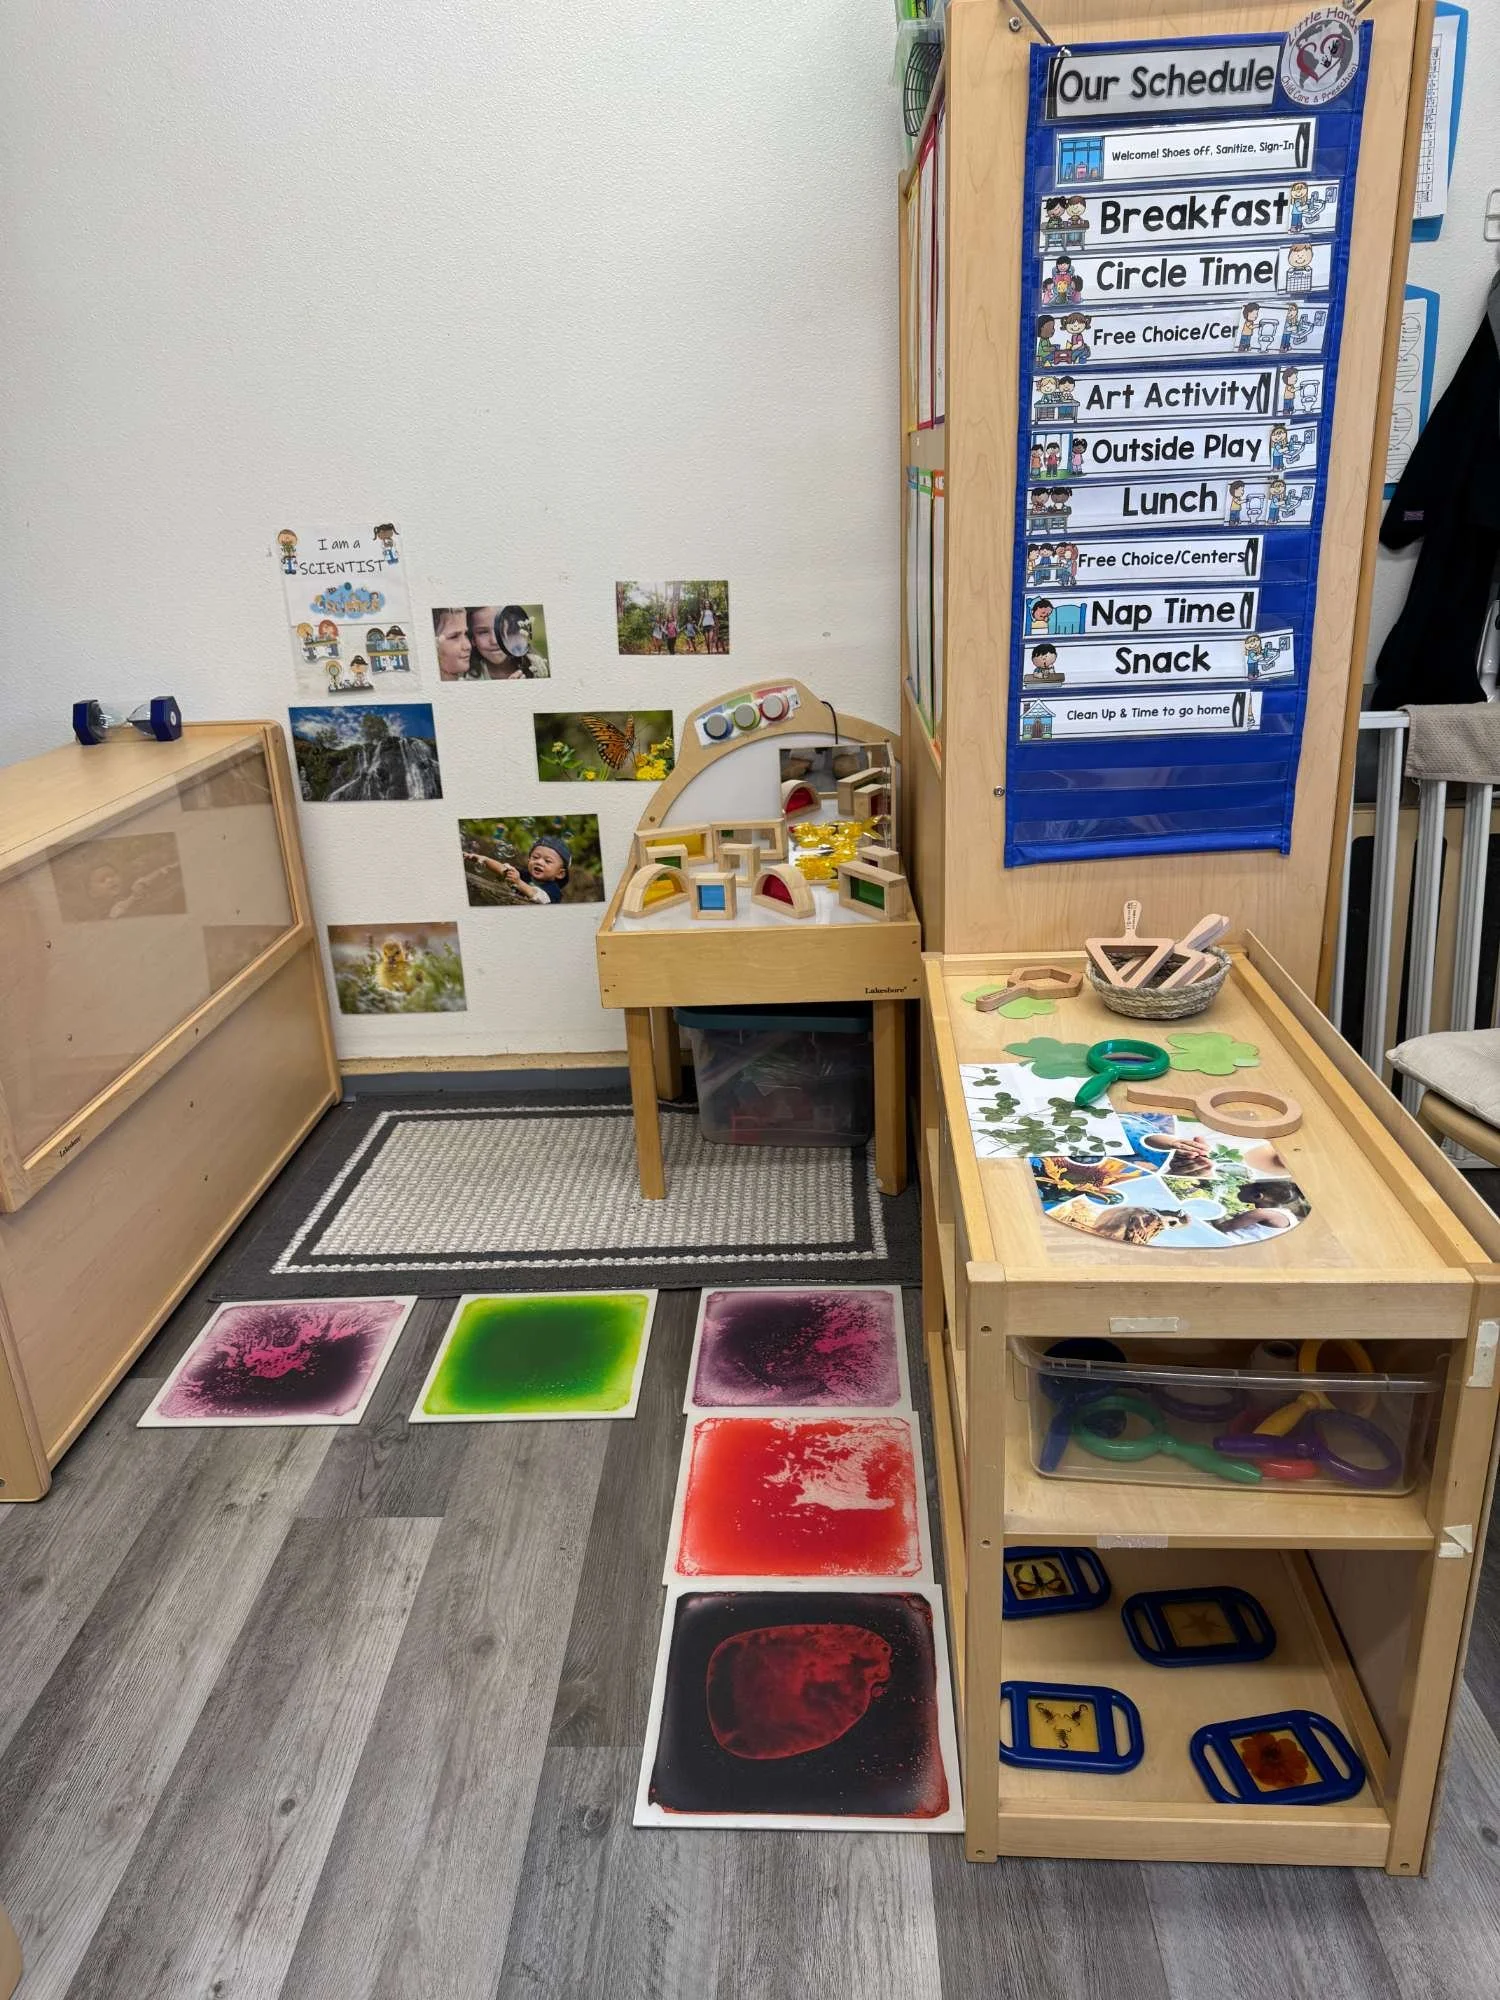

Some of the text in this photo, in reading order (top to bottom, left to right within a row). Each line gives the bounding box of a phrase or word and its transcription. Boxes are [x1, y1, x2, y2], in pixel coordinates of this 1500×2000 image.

[1288, 7, 1358, 46] Little Hands
[1059, 59, 1274, 103] Our Schedule
[1281, 75, 1296, 97] Child
[1294, 90, 1309, 103] Care
[1322, 64, 1358, 102] Preschool
[1112, 147, 1159, 161] Welcome!
[1161, 145, 1190, 158] Shoes
[1192, 143, 1213, 157] off,
[1259, 139, 1294, 154] Sign-In
[1100, 191, 1289, 235] Breakfast
[1096, 256, 1273, 291] Circle Time
[1093, 328, 1135, 345] Free
[1086, 378, 1256, 412] Art Activity
[1092, 434, 1262, 464] Outside Play
[1123, 483, 1218, 517] Lunch
[318, 538, 360, 550] I am a
[1078, 549, 1245, 568] Free Choice/Centers
[299, 560, 385, 575] SCIENTIST
[1091, 598, 1235, 630] Nap Time
[1115, 644, 1211, 675] Snack
[1067, 703, 1230, 721] Clean Up & Time to go home
